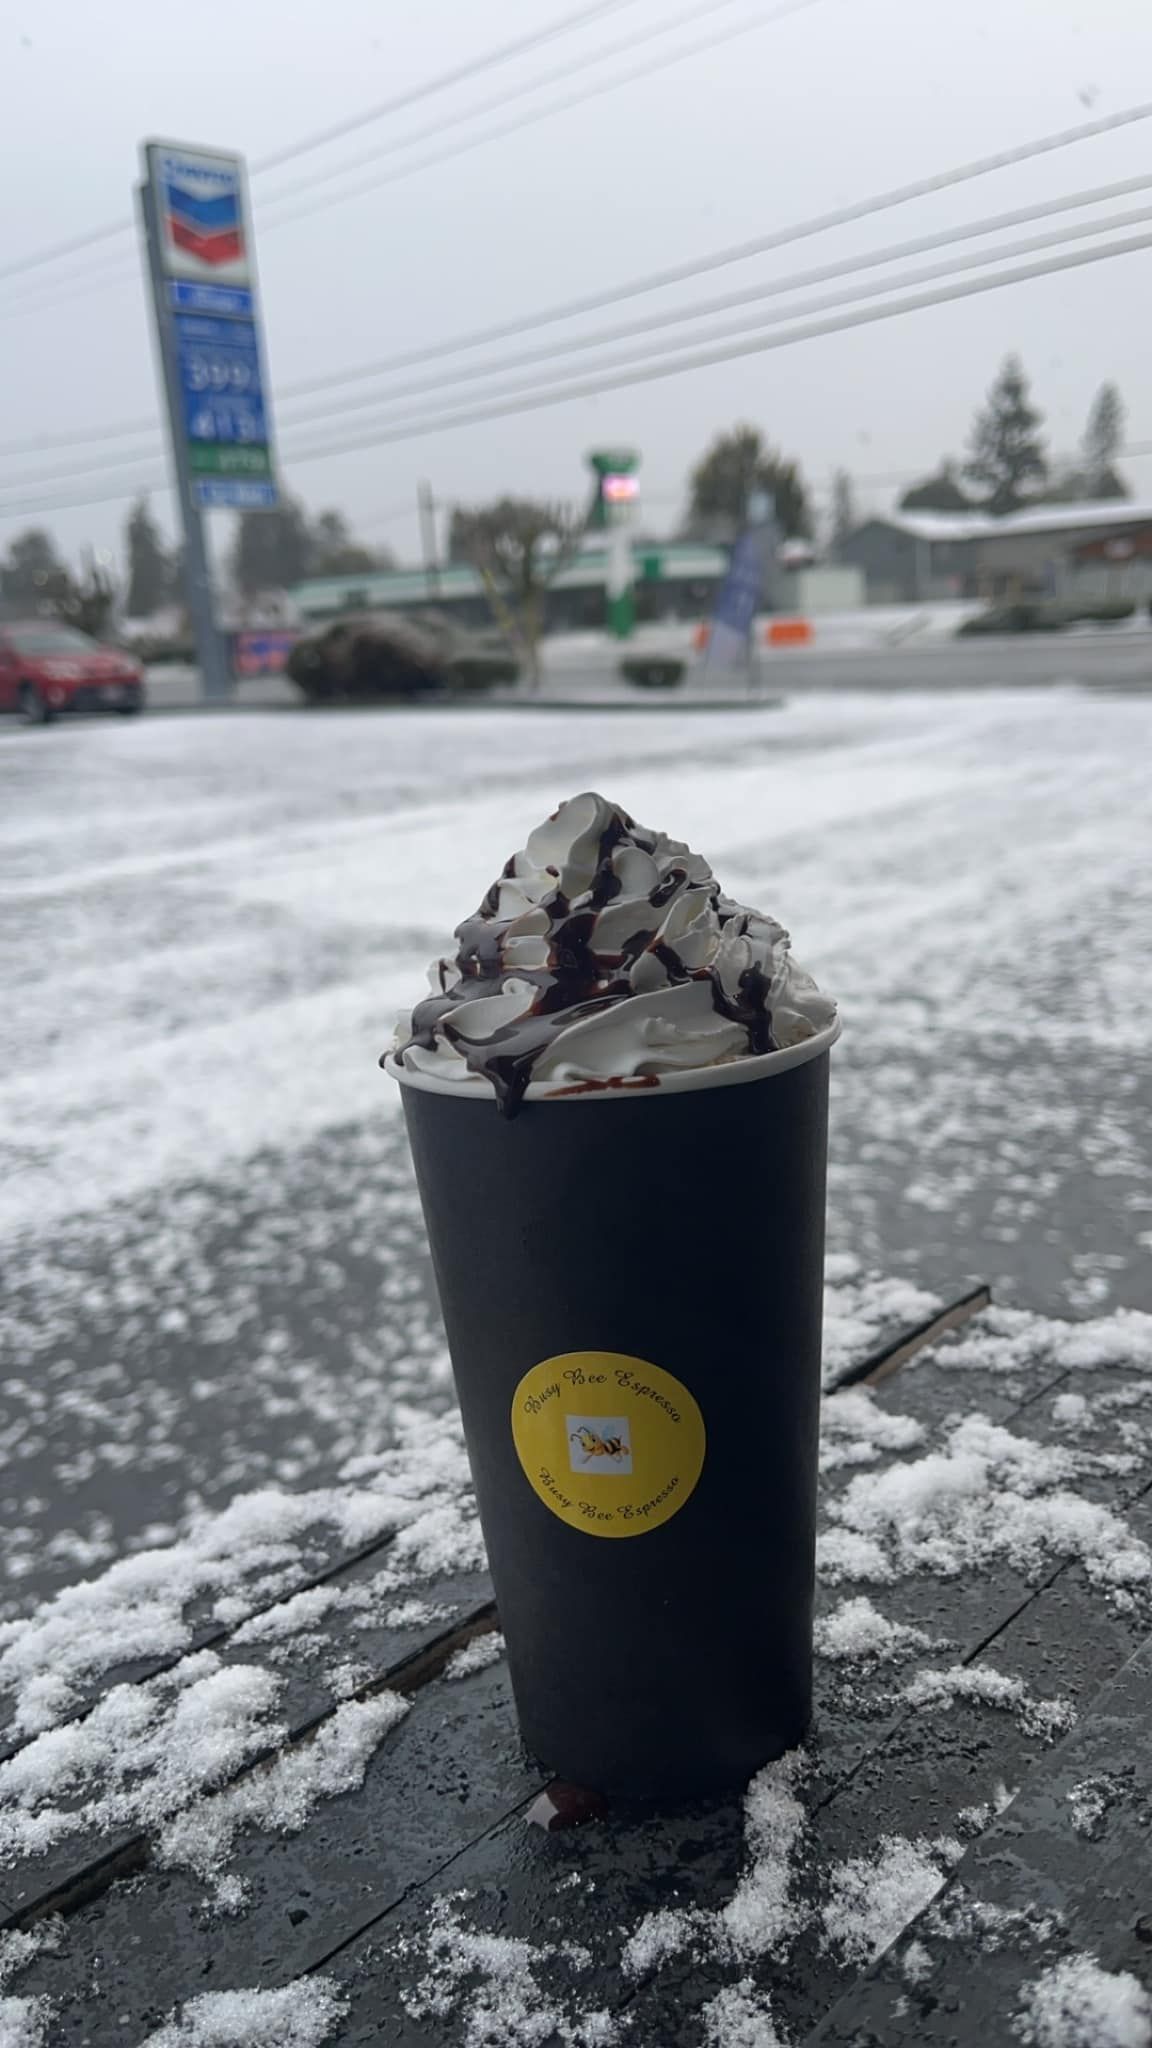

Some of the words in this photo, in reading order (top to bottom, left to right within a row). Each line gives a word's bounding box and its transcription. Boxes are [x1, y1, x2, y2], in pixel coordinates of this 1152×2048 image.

[523, 1382, 561, 1414] Busy
[562, 1367, 608, 1386] Bee
[614, 1369, 681, 1424] Espresso
[539, 1467, 574, 1508] Busy
[578, 1502, 614, 1521] Bee
[617, 1476, 680, 1519] Espresso
